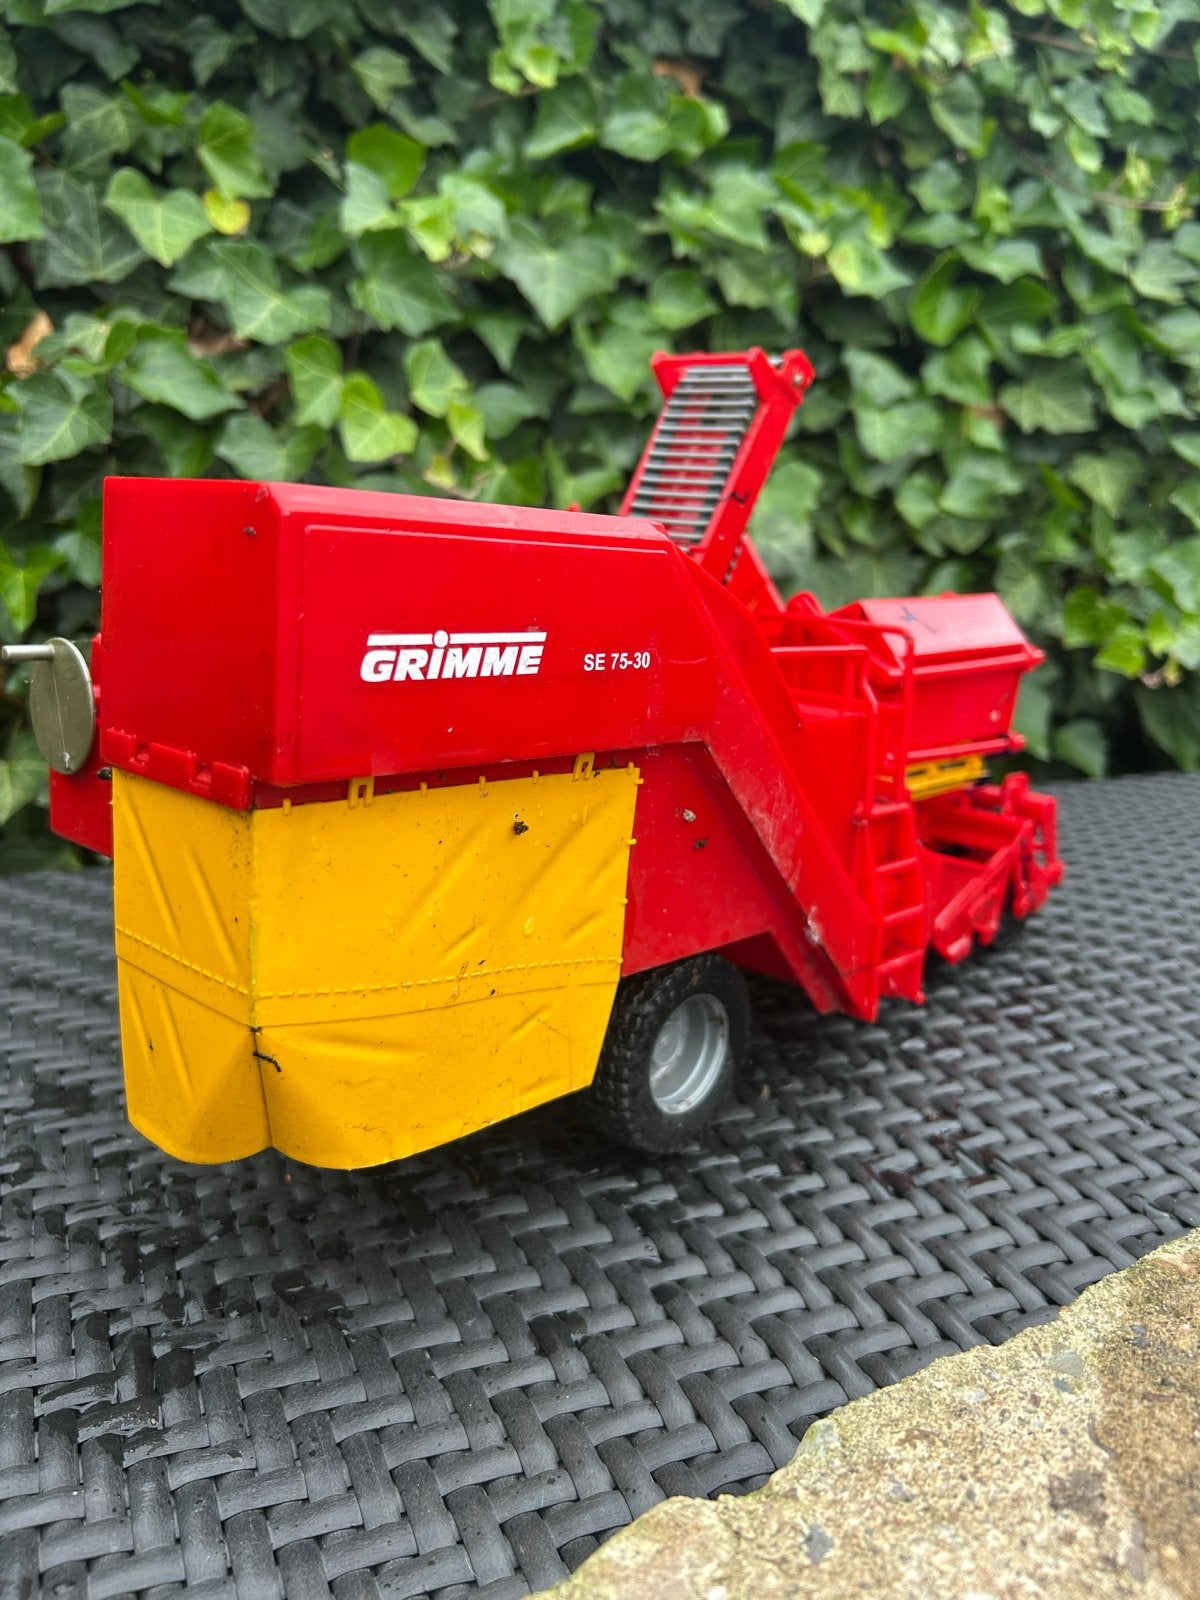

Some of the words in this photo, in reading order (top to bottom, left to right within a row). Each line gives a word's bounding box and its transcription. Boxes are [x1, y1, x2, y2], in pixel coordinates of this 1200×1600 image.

[360, 630, 545, 683] GRIMME
[583, 653, 606, 672] SE
[611, 651, 651, 670] 75-30
